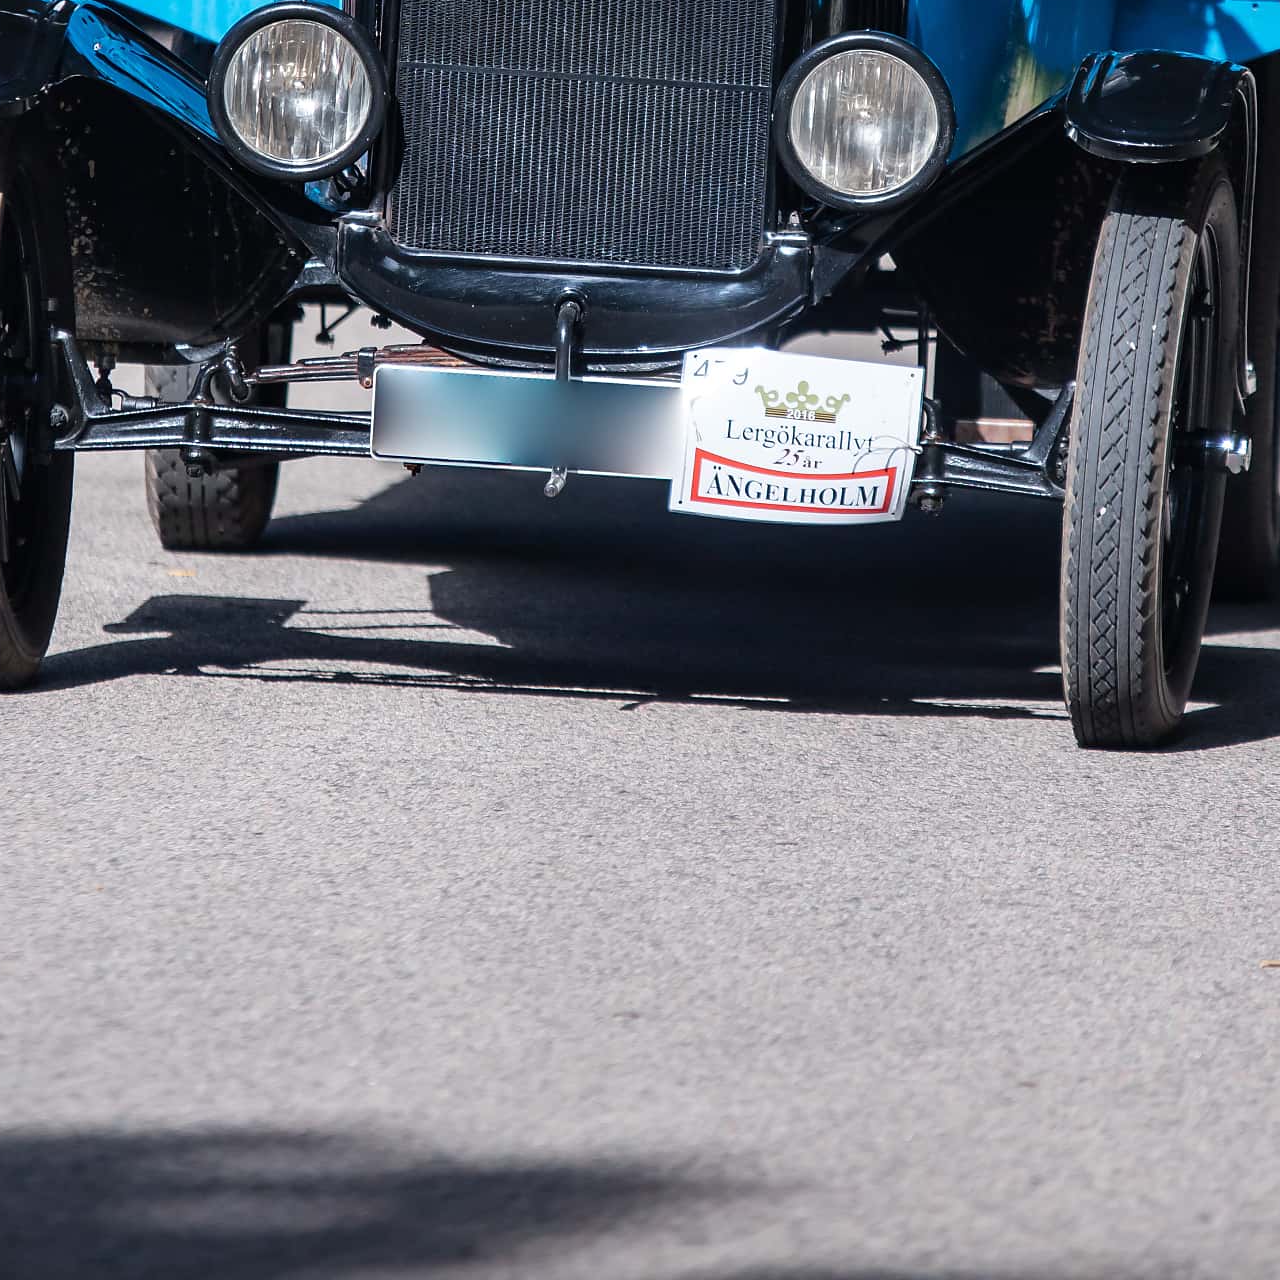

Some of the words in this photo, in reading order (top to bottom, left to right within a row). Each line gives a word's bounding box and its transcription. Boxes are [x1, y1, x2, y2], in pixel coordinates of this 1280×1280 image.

[727, 420, 874, 457] Lergökarallyt
[773, 448, 804, 466] 25
[803, 457, 823, 469] år
[706, 466, 880, 507] ÄNGELHOLM
